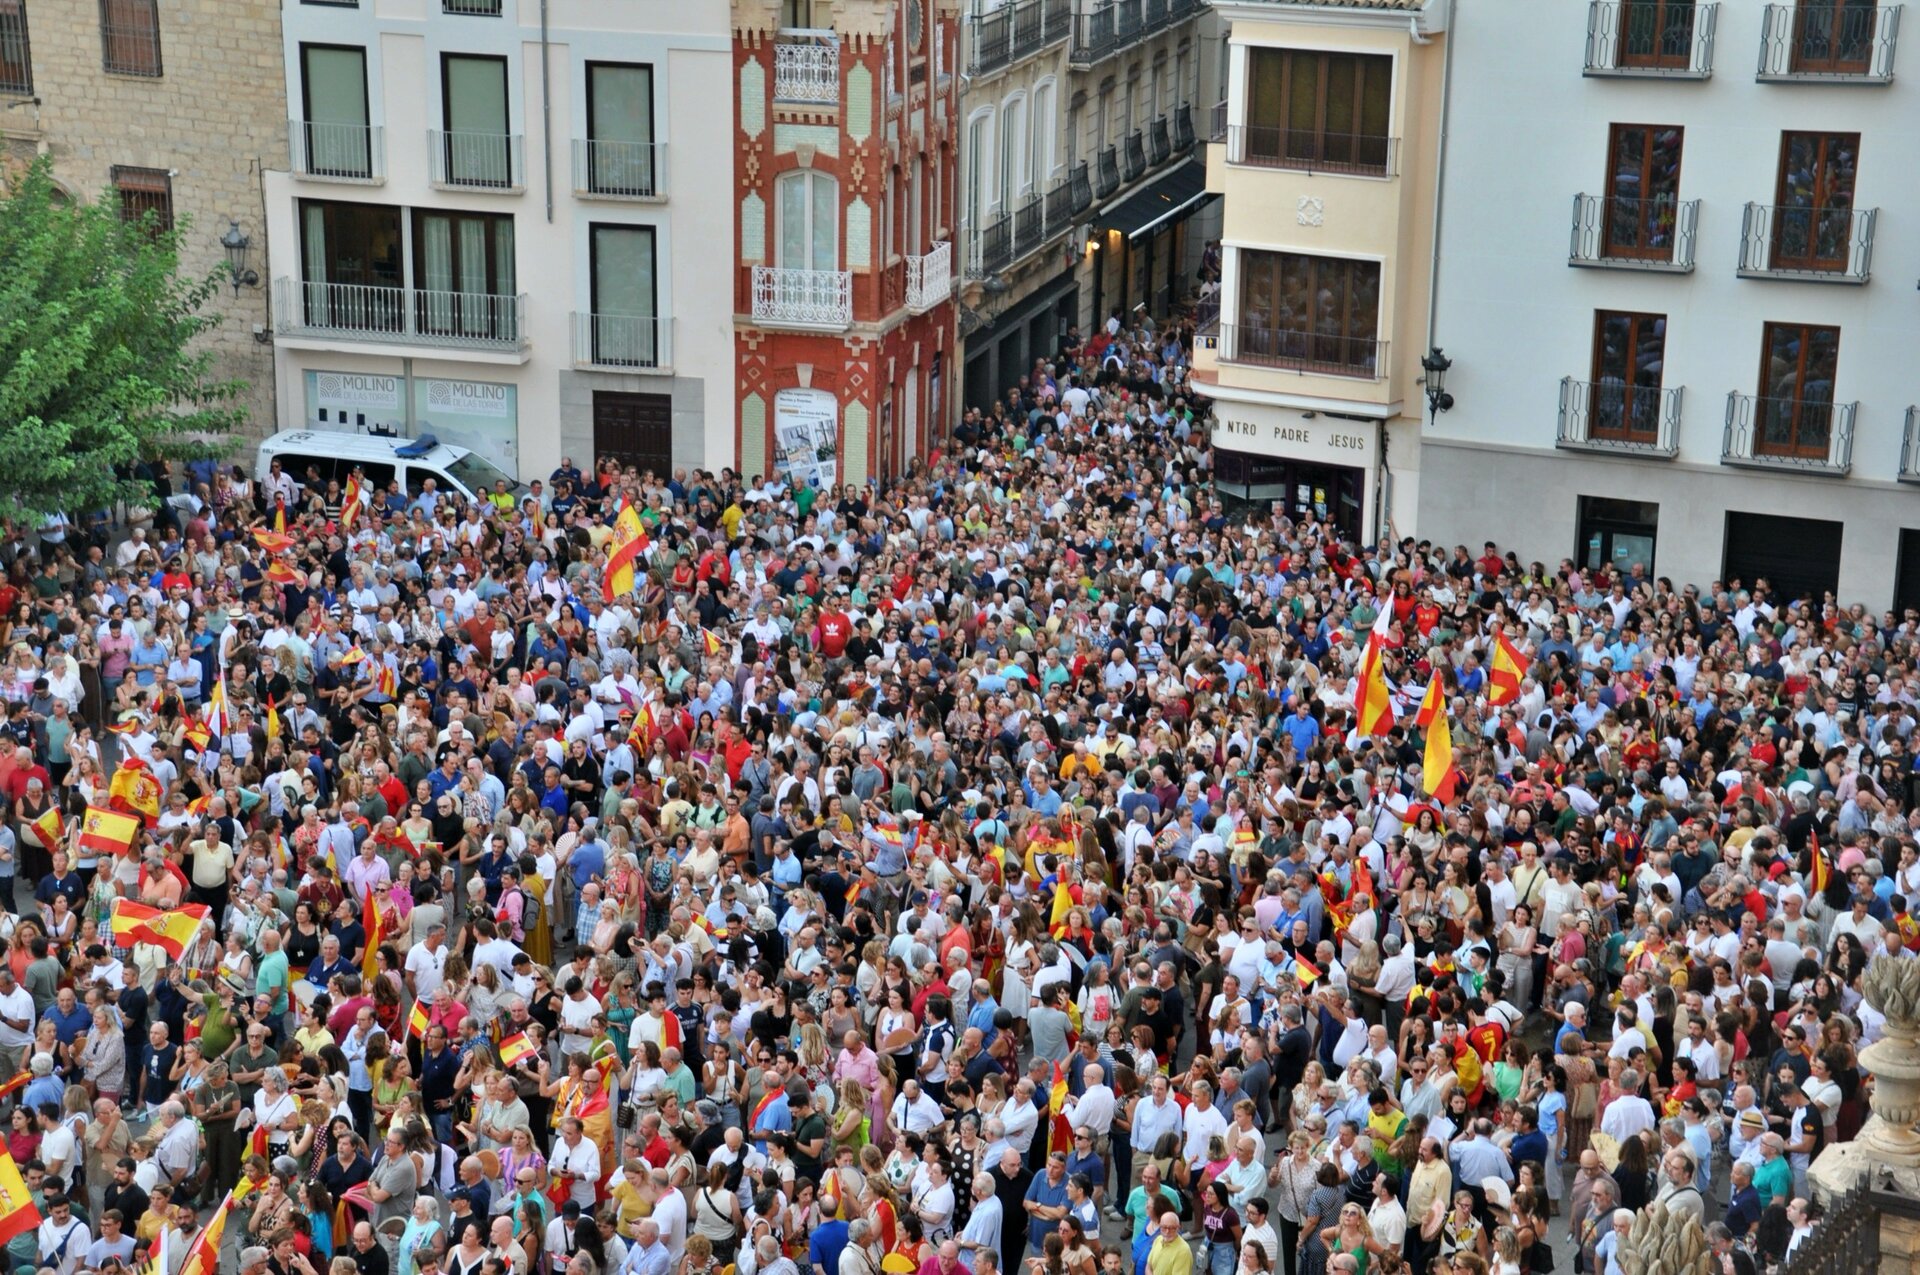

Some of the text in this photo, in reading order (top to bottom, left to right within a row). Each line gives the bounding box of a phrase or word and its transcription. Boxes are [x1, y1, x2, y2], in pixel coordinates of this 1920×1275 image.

[342, 376, 395, 393] MOLINO
[453, 383, 505, 400] MOLINO
[1227, 420, 1364, 450] NTRO PADRE JESUS
[1484, 1037, 1496, 1062] 7
